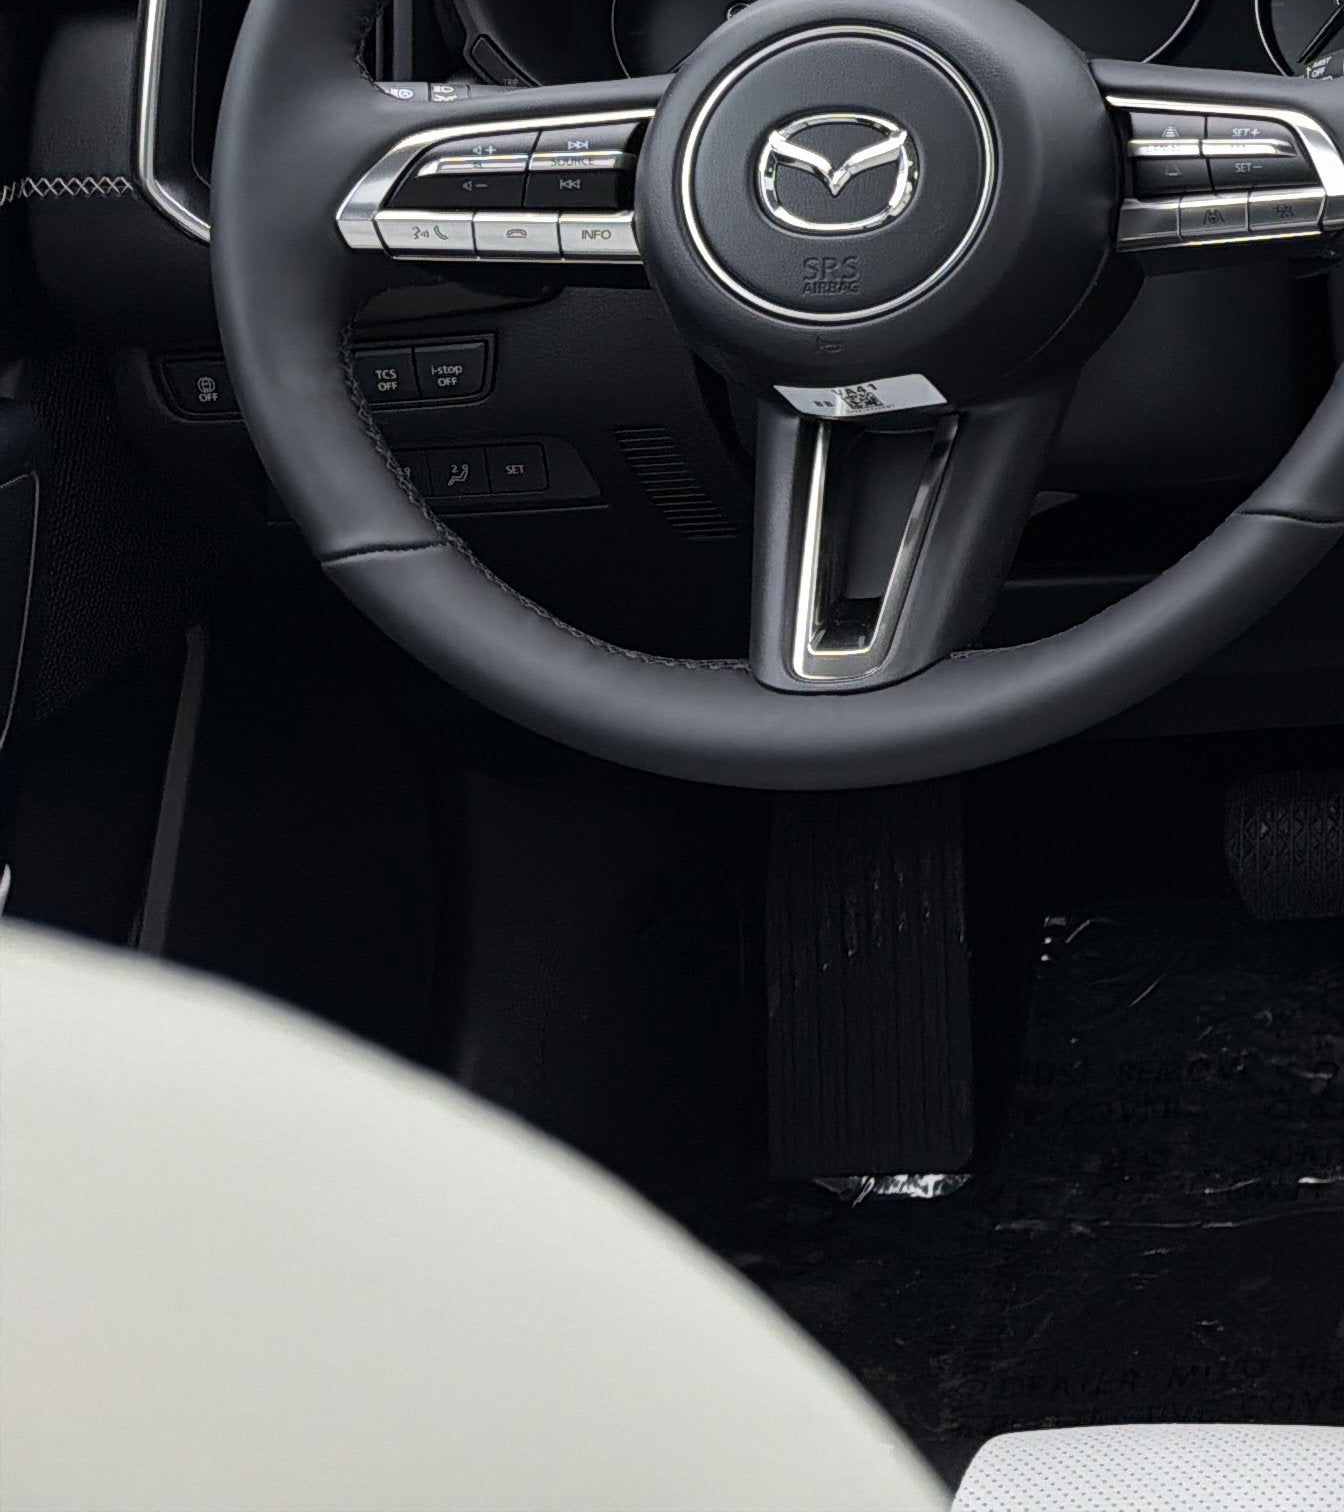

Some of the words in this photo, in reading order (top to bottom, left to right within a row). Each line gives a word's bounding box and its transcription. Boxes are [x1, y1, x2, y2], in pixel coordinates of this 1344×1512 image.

[581, 229, 612, 240] INFO
[803, 255, 859, 281] SRS
[802, 280, 860, 295] AIRBAG
[375, 368, 397, 380] TCS
[377, 381, 398, 392] OFF
[437, 376, 459, 387] OFF
[198, 392, 219, 403] OFF
[505, 464, 525, 475] SET
